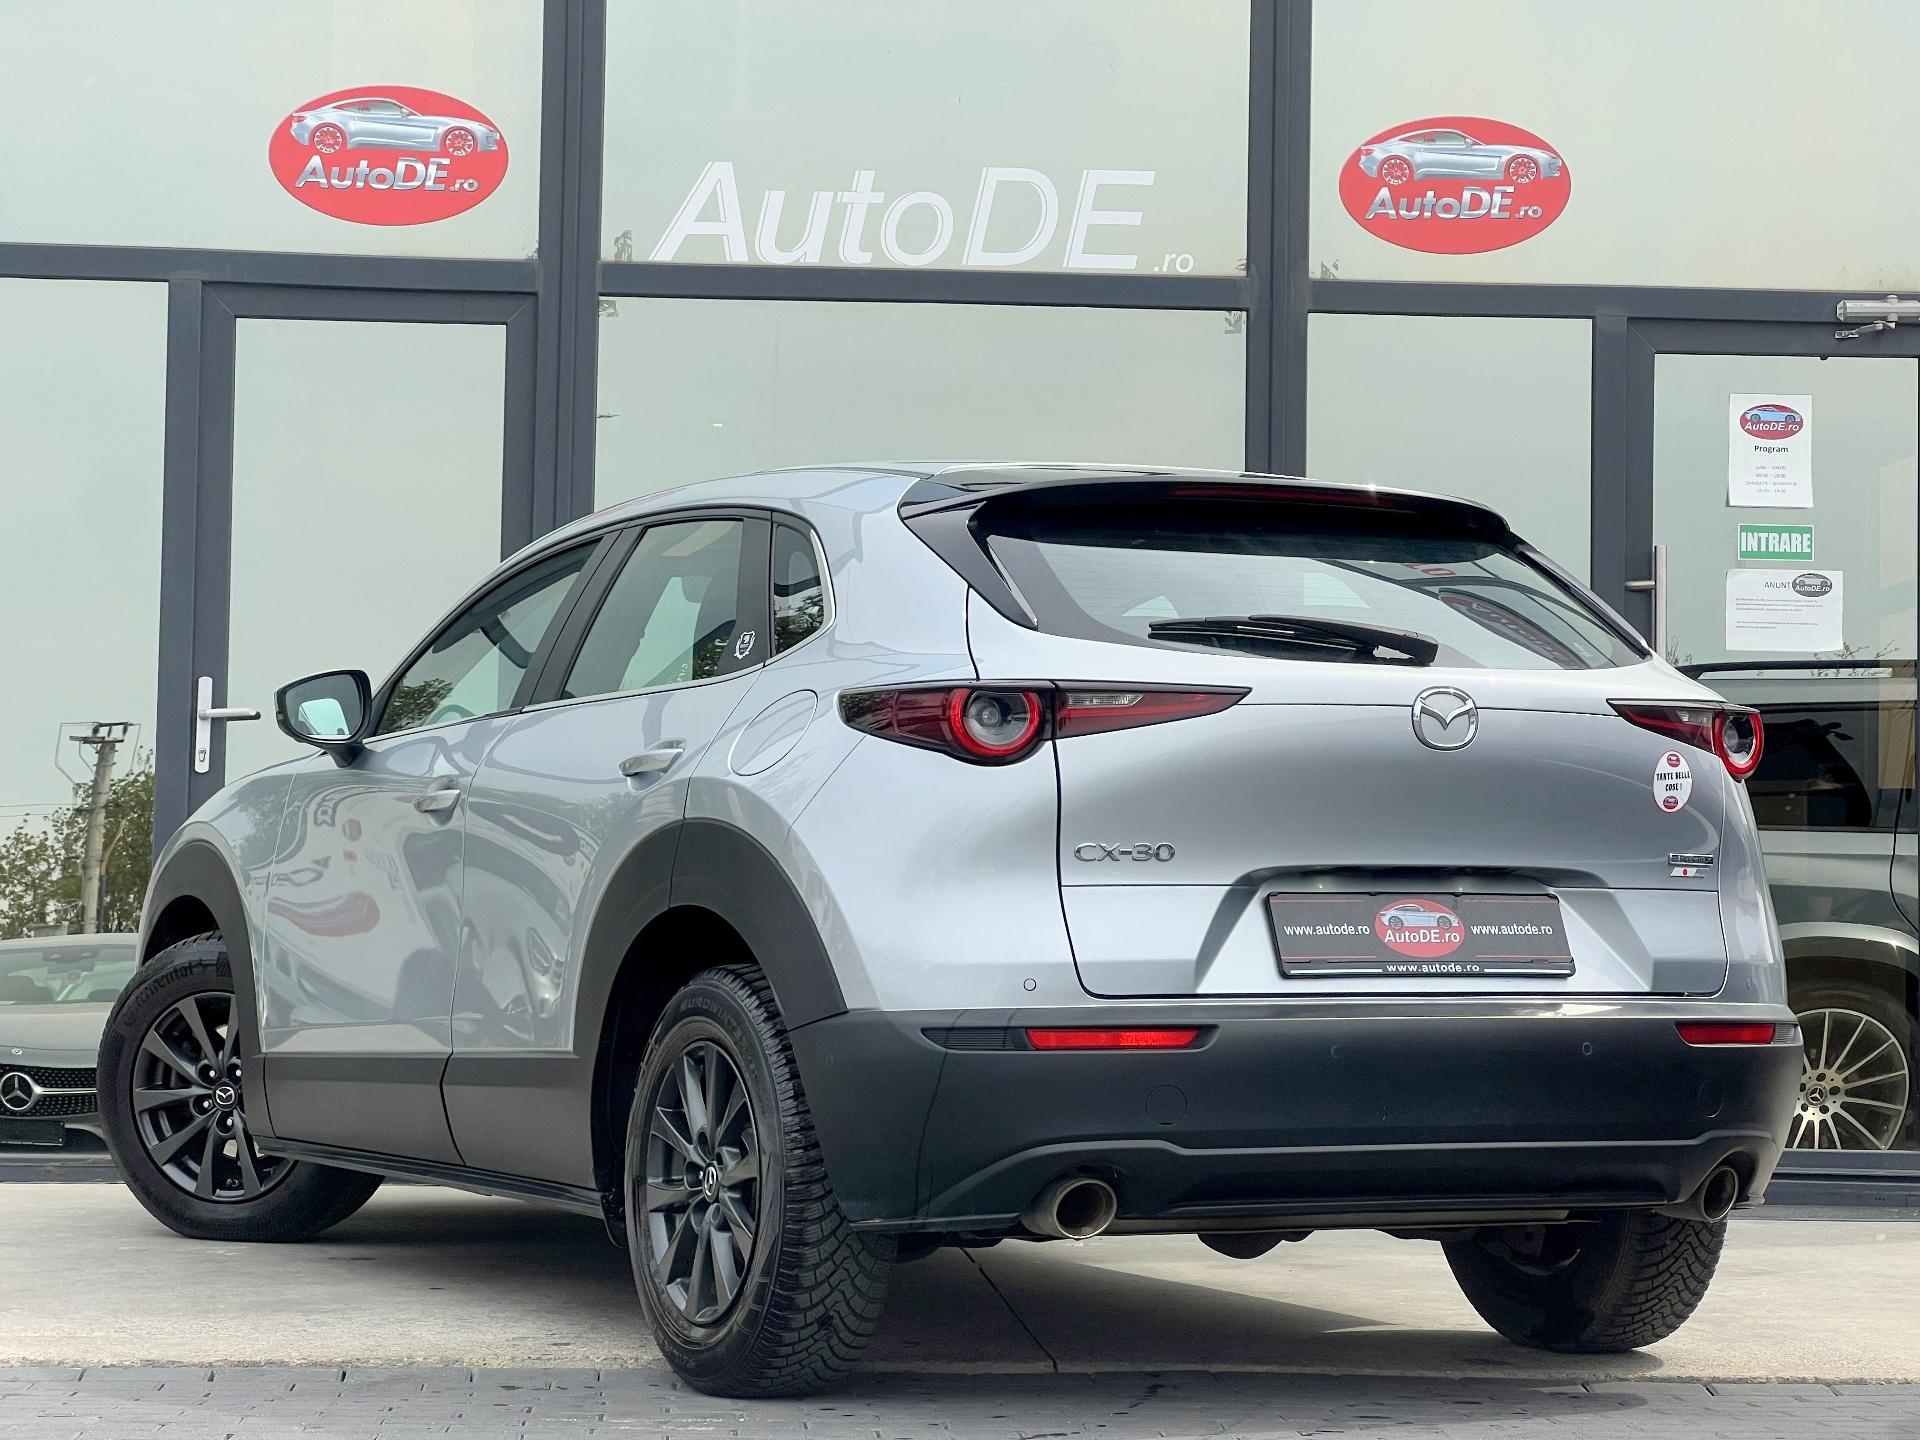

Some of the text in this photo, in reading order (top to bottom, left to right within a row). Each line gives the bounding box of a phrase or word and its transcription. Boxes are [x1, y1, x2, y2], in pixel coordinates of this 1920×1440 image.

[1744, 421, 1800, 432] AutoDE.ro
[1754, 445, 1789, 454] Program
[1740, 531, 1811, 553] INTRARE
[1656, 770, 1691, 781] TANTE BELLE
[1074, 842, 1176, 862] CX-30
[1283, 923, 1370, 936] www.autode.ro
[1384, 929, 1461, 943] AutoDE.ro
[1470, 923, 1553, 936] www.autode.ro
[1385, 963, 1480, 973] www.autode.ro
